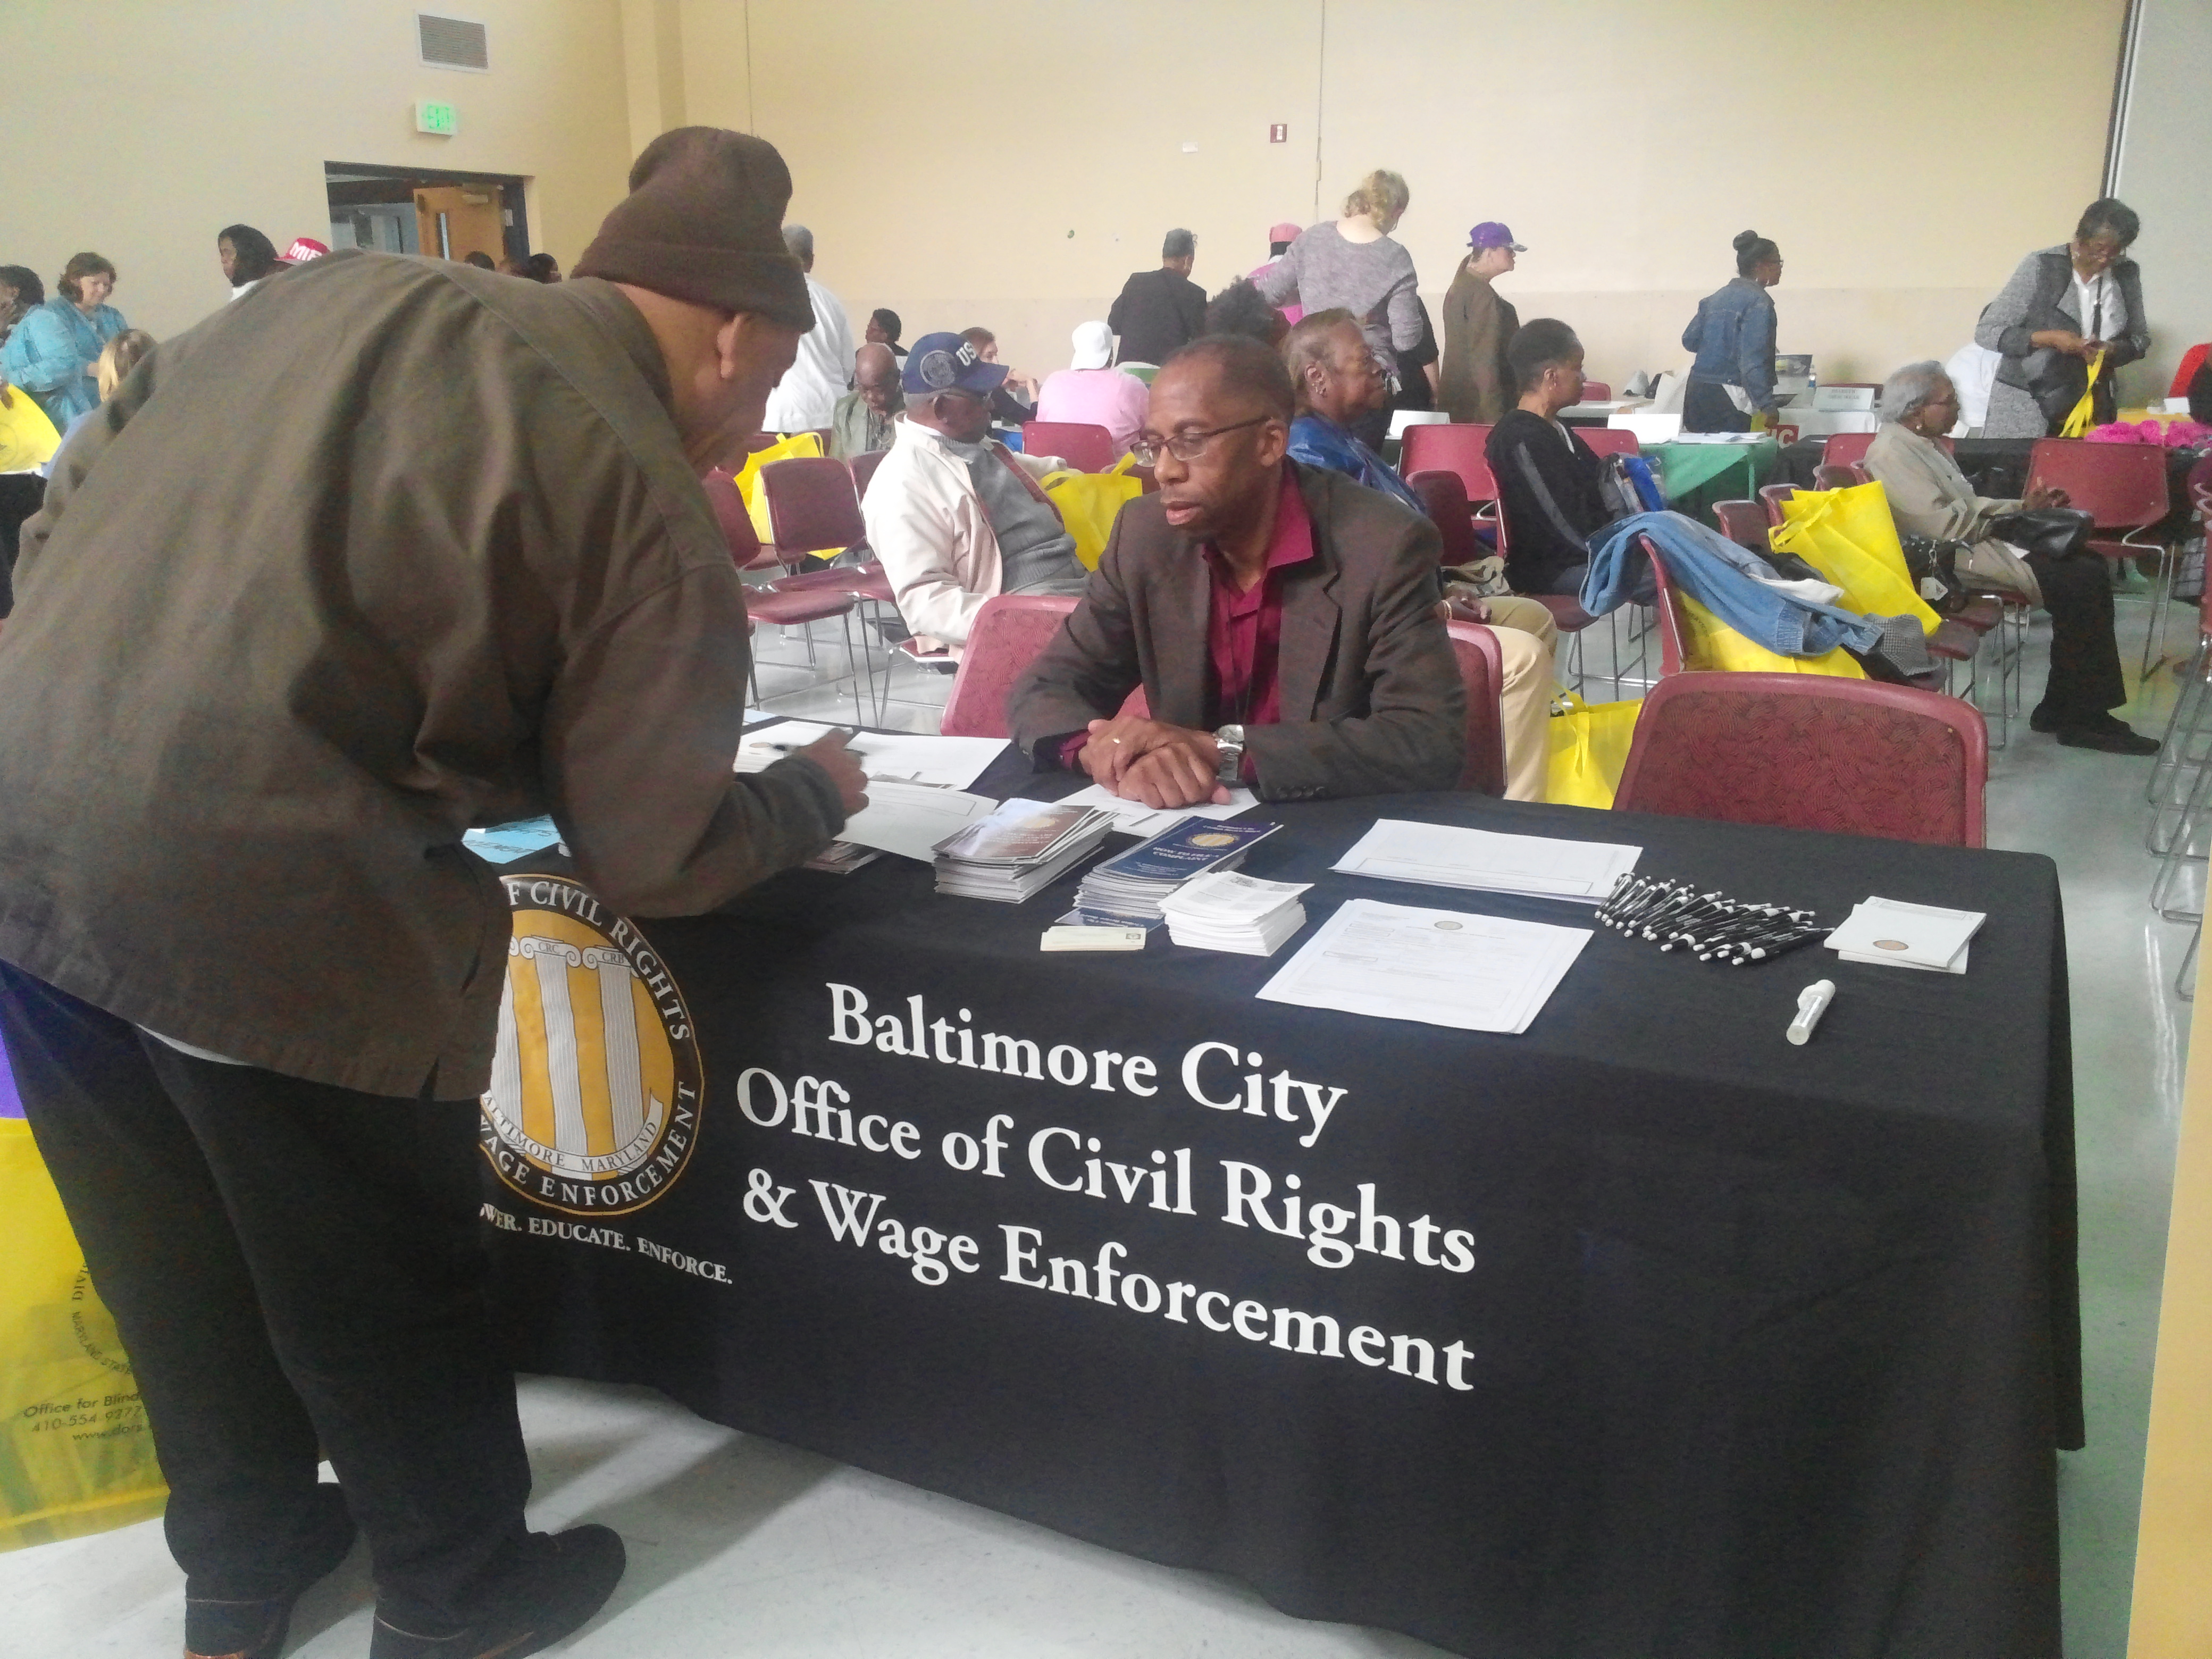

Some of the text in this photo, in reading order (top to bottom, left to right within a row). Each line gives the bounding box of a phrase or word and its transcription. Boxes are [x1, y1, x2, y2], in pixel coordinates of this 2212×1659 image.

[530, 881, 602, 927] CIVIL
[609, 917, 690, 1040] RIGHTS
[538, 942, 559, 954] CRC
[602, 951, 624, 964] CRB
[826, 983, 1348, 1148] Baltimore City
[484, 1096, 658, 1171] ALTIMORE MARYLAND
[539, 1082, 696, 1206] ENFORCEMENT
[738, 1068, 1475, 1273] Office of Civil Rights
[528, 1217, 631, 1251] EDUCATE.
[637, 1237, 733, 1285] ENFORCE.
[743, 1168, 1474, 1390] & Wage Enforcement
[23, 1402, 71, 1418] Office
[77, 1398, 98, 1409] for
